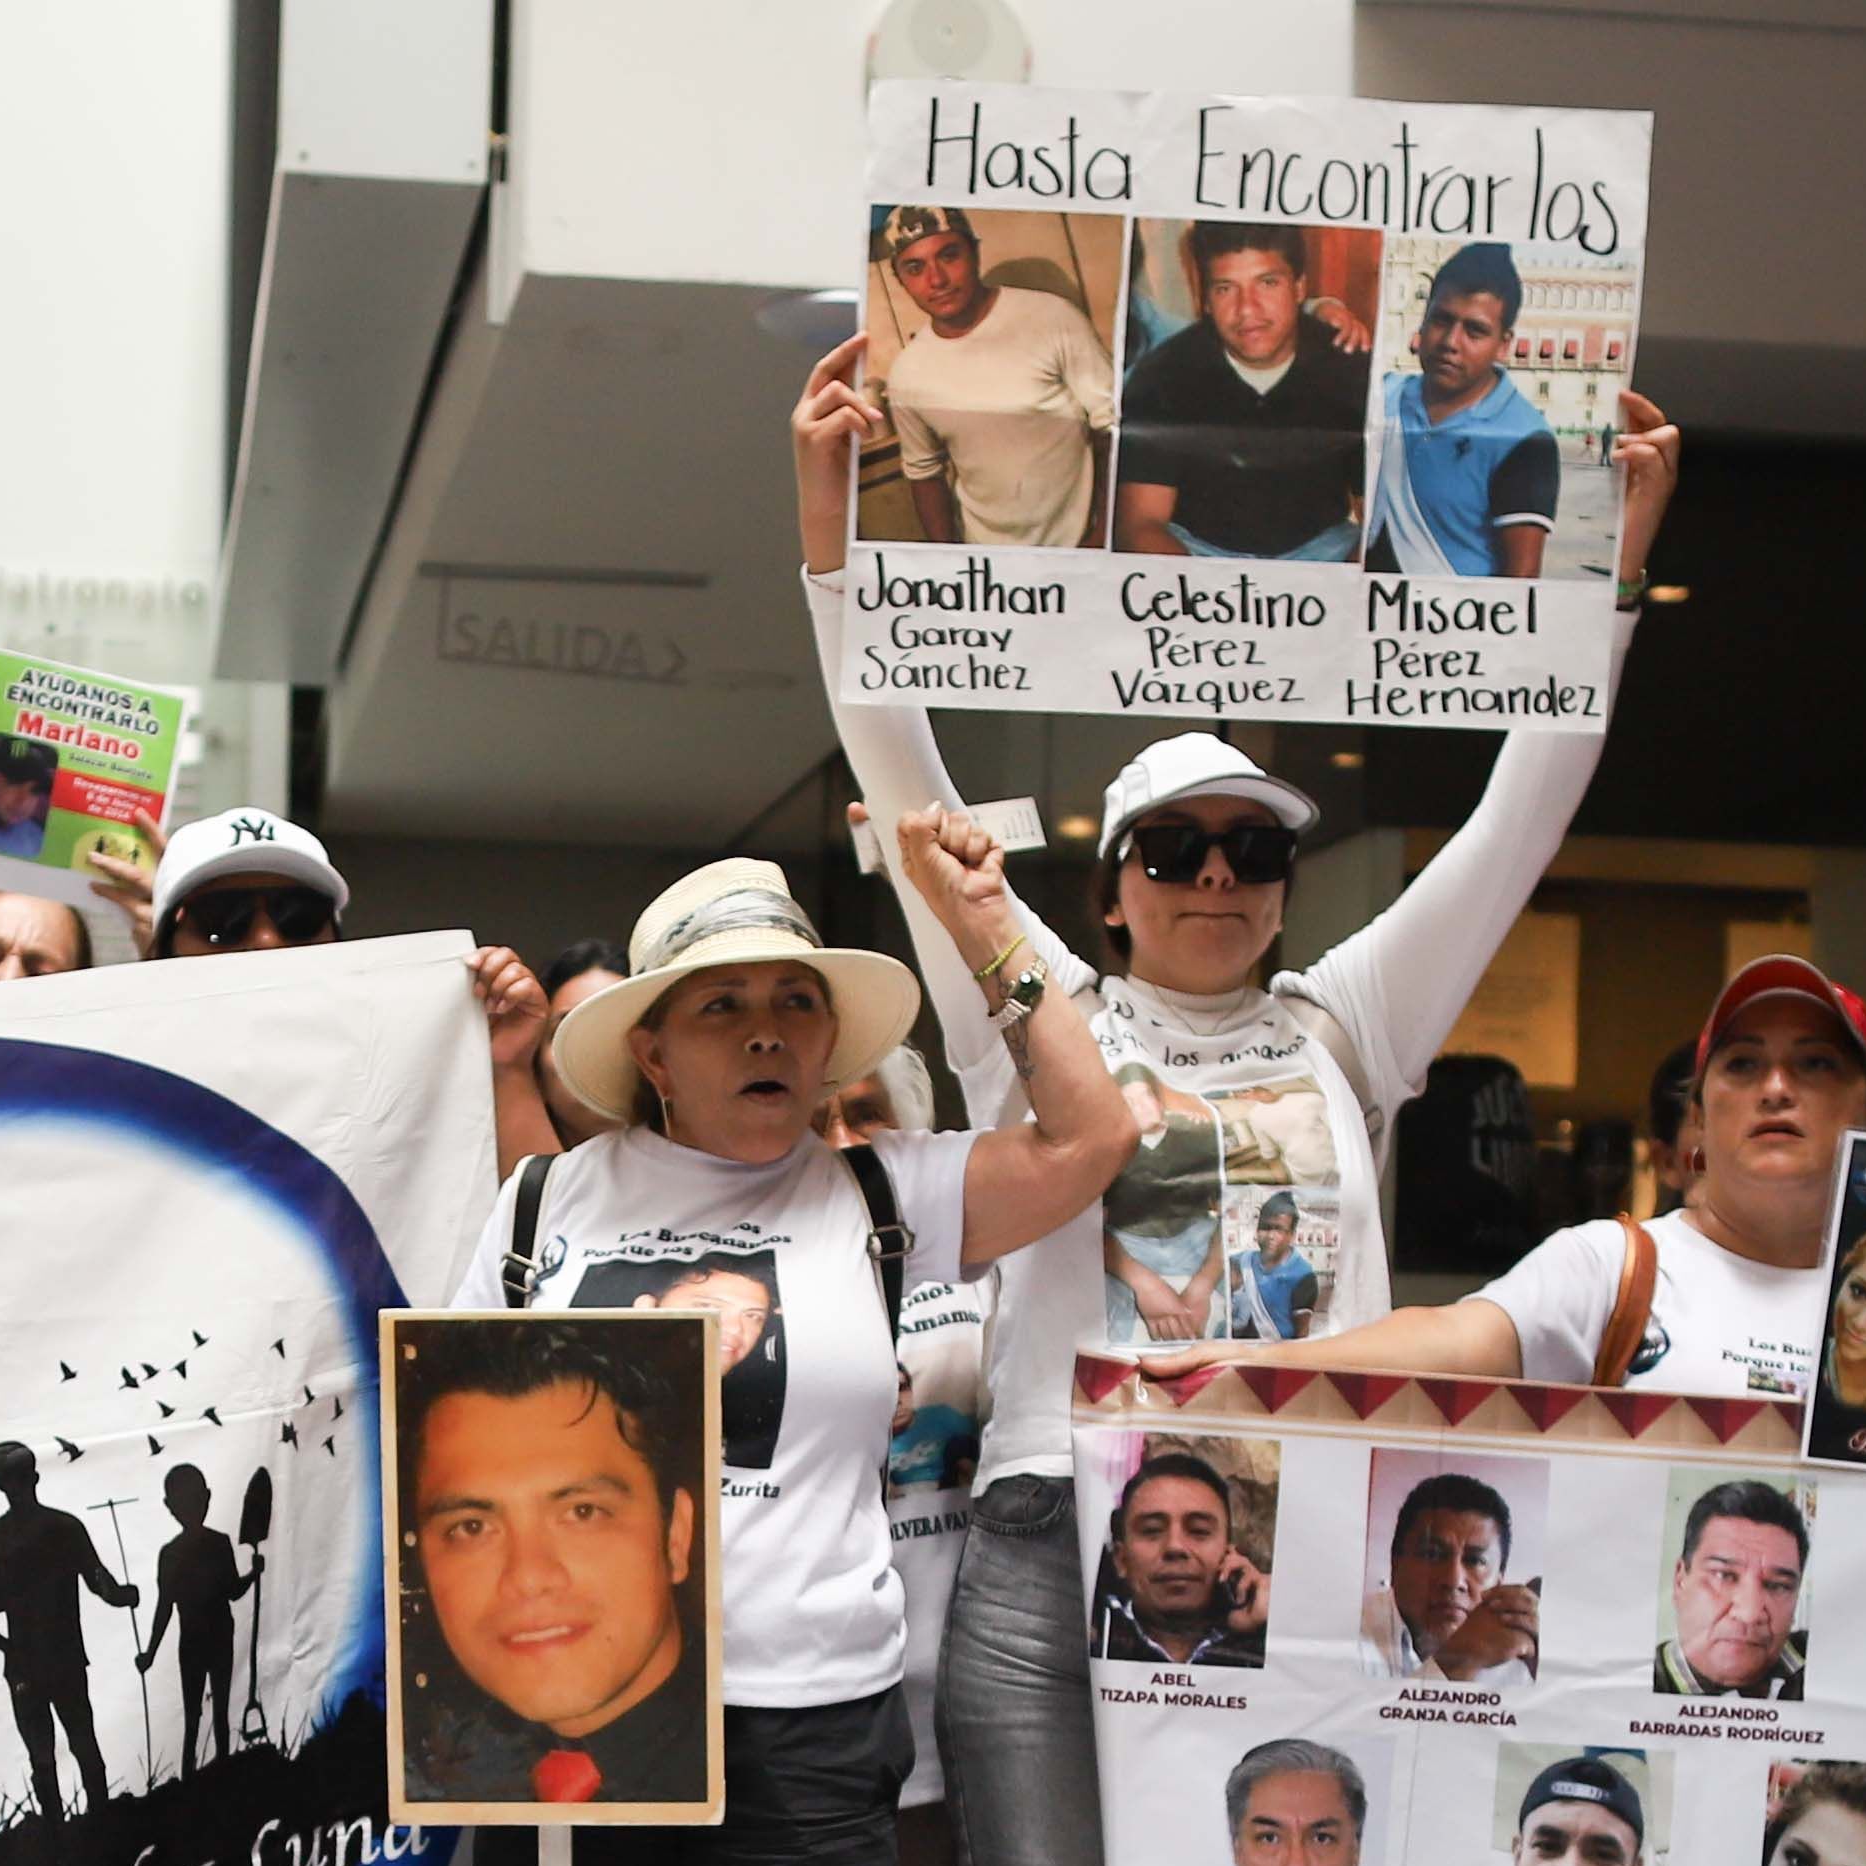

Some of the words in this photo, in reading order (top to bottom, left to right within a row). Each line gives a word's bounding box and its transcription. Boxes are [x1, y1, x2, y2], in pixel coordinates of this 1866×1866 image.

[926, 97, 1133, 201] Hasta
[857, 554, 1066, 615] Jonathan
[1121, 572, 1326, 628] Celestino
[1367, 580, 1537, 634] Misael
[890, 615, 1013, 654] Garay
[1146, 626, 1266, 669] Pérez
[860, 647, 1033, 693] Sánchez
[1374, 640, 1484, 680] Pérez
[7, 685, 159, 735] ENCONTRARLO
[139, 700, 151, 714] A
[1112, 669, 1305, 714] Vázquez
[1345, 677, 1602, 719] Hernandez
[18, 711, 140, 758] Mariano
[1164, 1044, 1199, 1068] los
[719, 1477, 780, 1499] Zurita
[1100, 1686, 1159, 1708] TIZAPA
[1162, 1692, 1248, 1710] MORALES
[1149, 1671, 1197, 1689] ABEL
[1398, 1686, 1502, 1708] ALEJANDRO
[1379, 1705, 1448, 1724] GRANJA
[1452, 1707, 1517, 1728] GARCÍA
